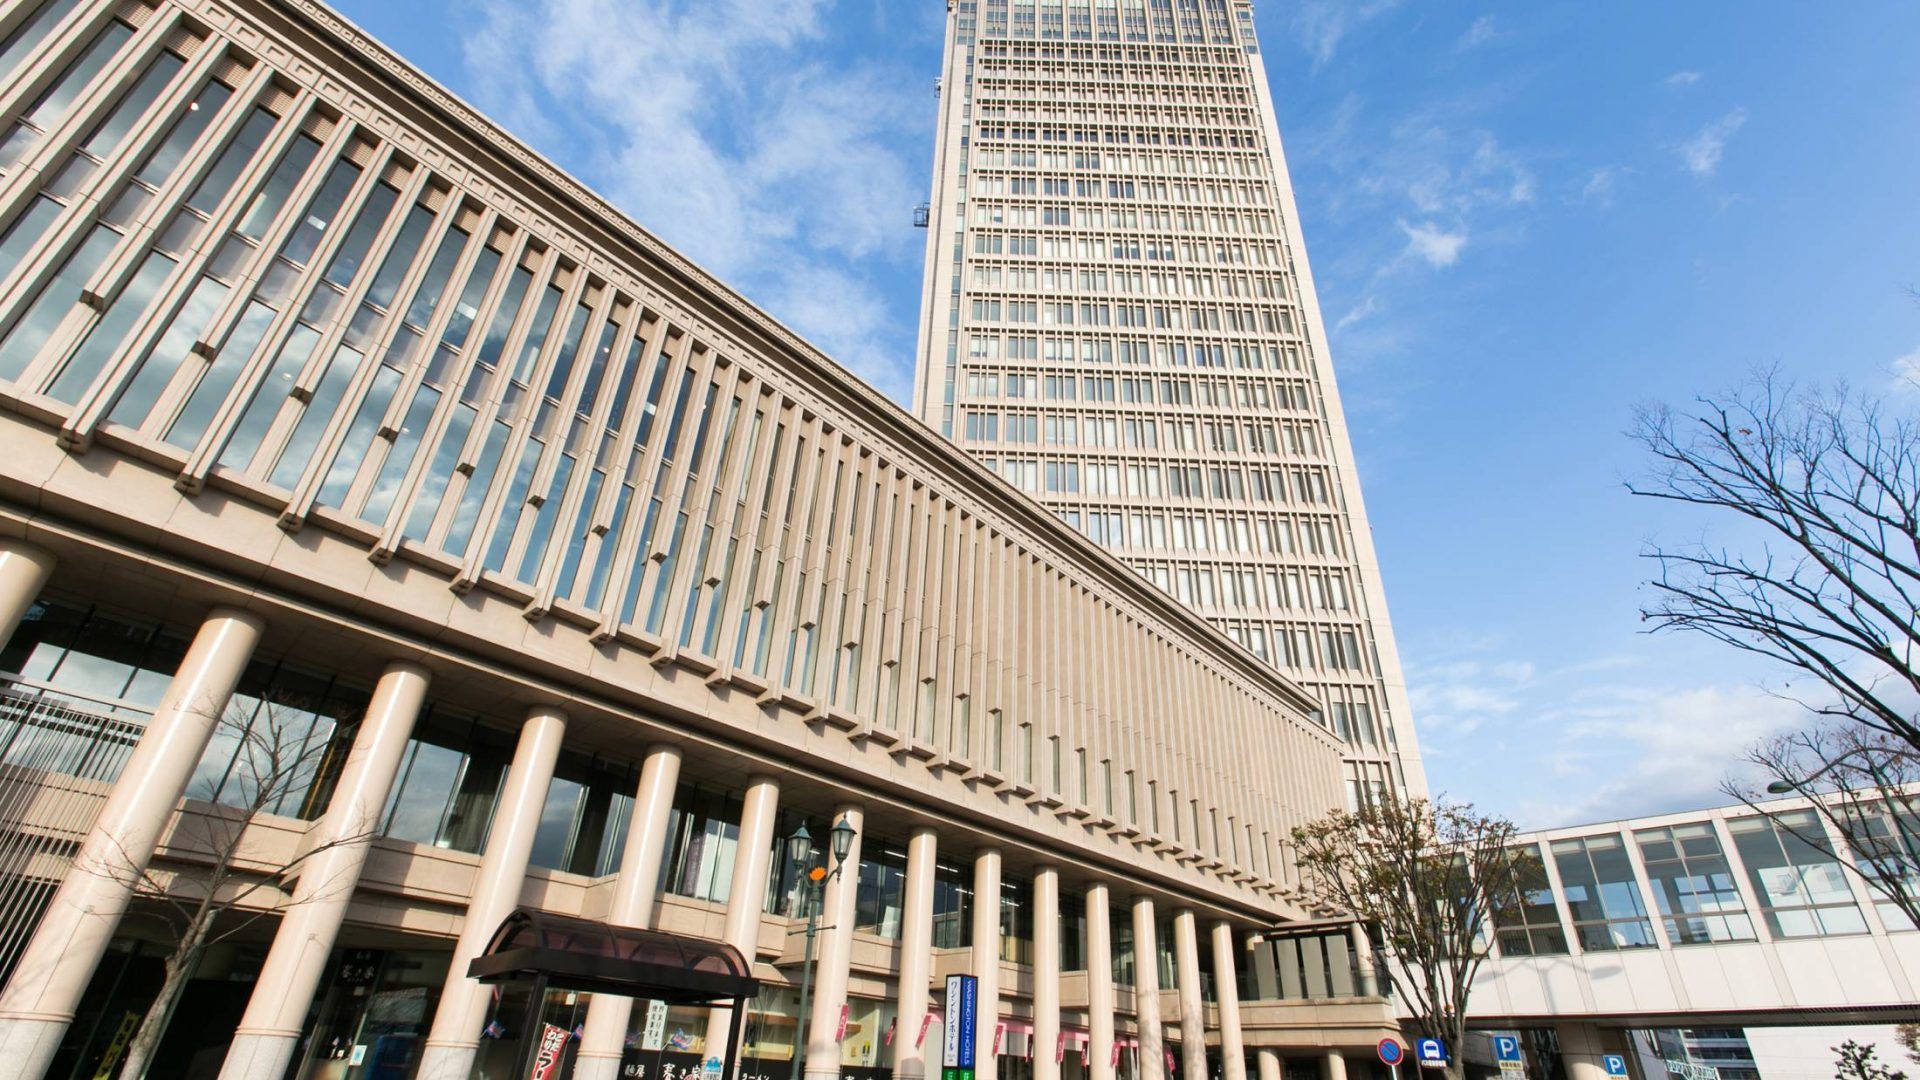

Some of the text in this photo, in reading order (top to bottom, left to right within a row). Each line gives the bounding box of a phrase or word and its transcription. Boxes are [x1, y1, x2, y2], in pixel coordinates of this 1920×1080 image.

[949, 981, 958, 1051] ワシントンホテル
[964, 980, 973, 1034] WASHINGTON
[963, 1036, 971, 1065] HOTELS
[1500, 1039, 1514, 1058] P
[1609, 1057, 1621, 1073] P
